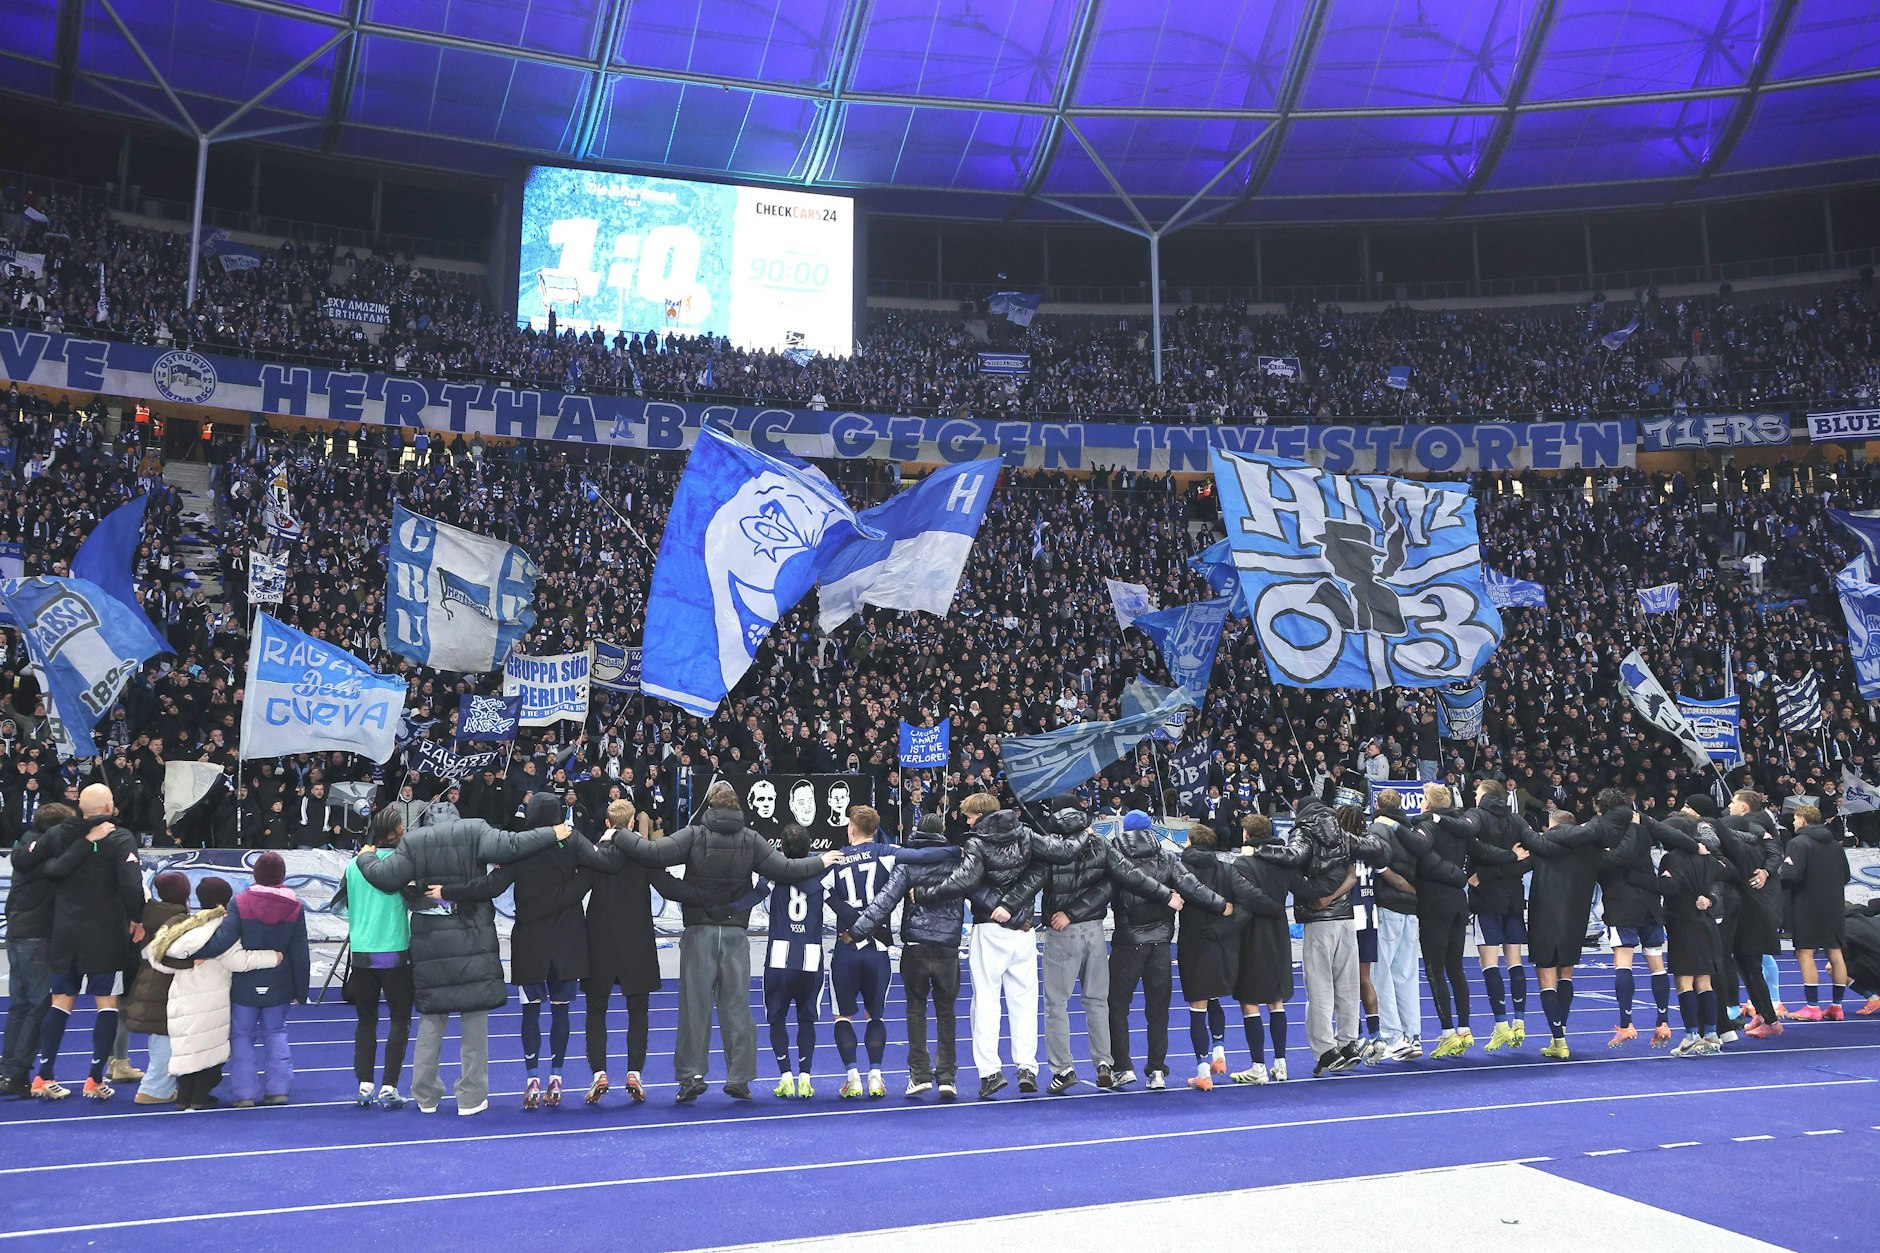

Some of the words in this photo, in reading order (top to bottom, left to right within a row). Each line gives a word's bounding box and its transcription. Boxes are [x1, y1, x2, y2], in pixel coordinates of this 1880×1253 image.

[756, 202, 837, 222] CHECKCARS24
[540, 217, 703, 303] 1:0
[749, 257, 829, 286] 90:00
[348, 300, 390, 314] AMAZING
[160, 353, 211, 375] OSTKURVE
[259, 364, 598, 443] HERTHA
[829, 412, 1085, 469] GEGEN
[1134, 421, 1623, 472] INVESTOREN
[1643, 415, 1793, 448] 71ERS
[945, 472, 985, 514] H
[507, 656, 558, 684] GRUPPA
[561, 655, 588, 683] SÜD
[78, 657, 138, 718] 1892
[520, 683, 576, 708] BERLIN
[266, 697, 389, 730] CURVA
[910, 745, 926, 754] IST
[911, 734, 939, 745] KAMPF
[900, 752, 946, 763] VERLOREN
[838, 861, 877, 909] 17
[790, 923, 806, 933] SESSA
